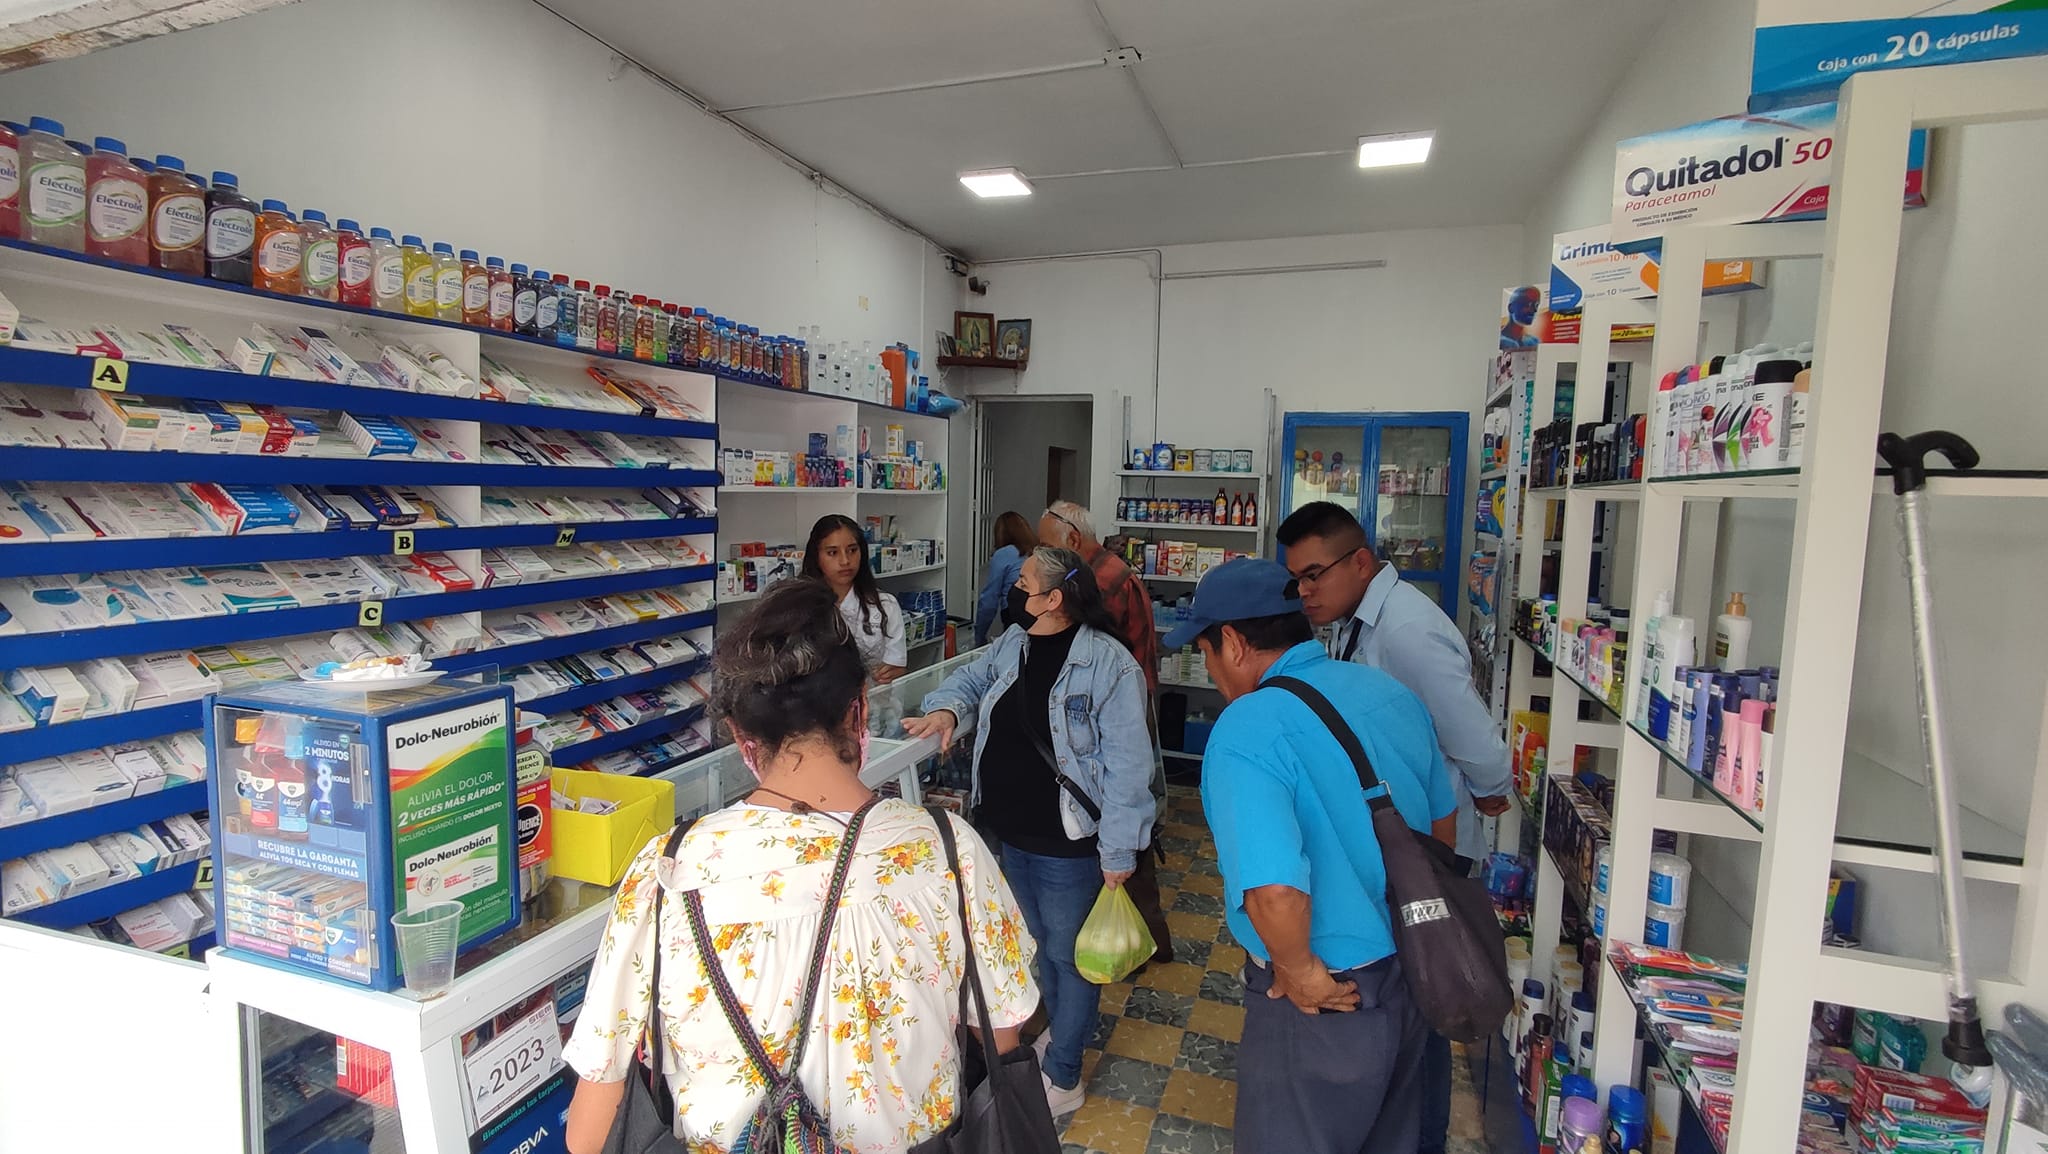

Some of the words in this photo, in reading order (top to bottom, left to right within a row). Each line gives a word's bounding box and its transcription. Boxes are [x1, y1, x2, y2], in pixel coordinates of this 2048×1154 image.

[1817, 58, 1847, 72] Caja
[1852, 52, 1878, 66] con
[1884, 31, 1929, 62] 20
[1936, 23, 2020, 50] cápsulas
[1625, 137, 1784, 197] Quitadol
[1624, 184, 1717, 213] Paracetamol
[1804, 194, 1825, 206] Caja
[1609, 254, 1620, 263] 10
[1607, 288, 1617, 297] 10
[96, 365, 122, 384] A
[398, 535, 410, 551] B
[559, 531, 574, 543] M
[364, 607, 379, 620] C
[395, 713, 498, 750] Dolo-Neurobión
[305, 746, 311, 755] 2
[312, 748, 350, 761] MINUTOS
[407, 789, 443, 809] ALIVIA
[445, 785, 458, 796] EL
[459, 771, 494, 791] DOLOR
[398, 812, 409, 828] 2
[410, 803, 443, 821] VECES
[444, 795, 466, 809] MÁS
[398, 829, 427, 844] INCLUSO
[427, 819, 454, 834] CUANDO
[463, 808, 484, 820] DOLOR
[484, 801, 503, 812] MIXTO
[258, 840, 295, 857] RECUBRE
[297, 849, 308, 859] LA
[309, 851, 358, 869] GARGANTA
[260, 852, 281, 861] ALIVIA
[281, 855, 294, 864] TOS
[294, 858, 312, 869] SECA
[318, 864, 333, 873] CON
[334, 866, 360, 878] FLEMAS
[409, 836, 493, 872] Dolo-Neurobión
[489, 1038, 545, 1095] 2023
[482, 1103, 526, 1142] Bienvenidas
[526, 1095, 537, 1109] las
[537, 1077, 565, 1101] tarjetas
